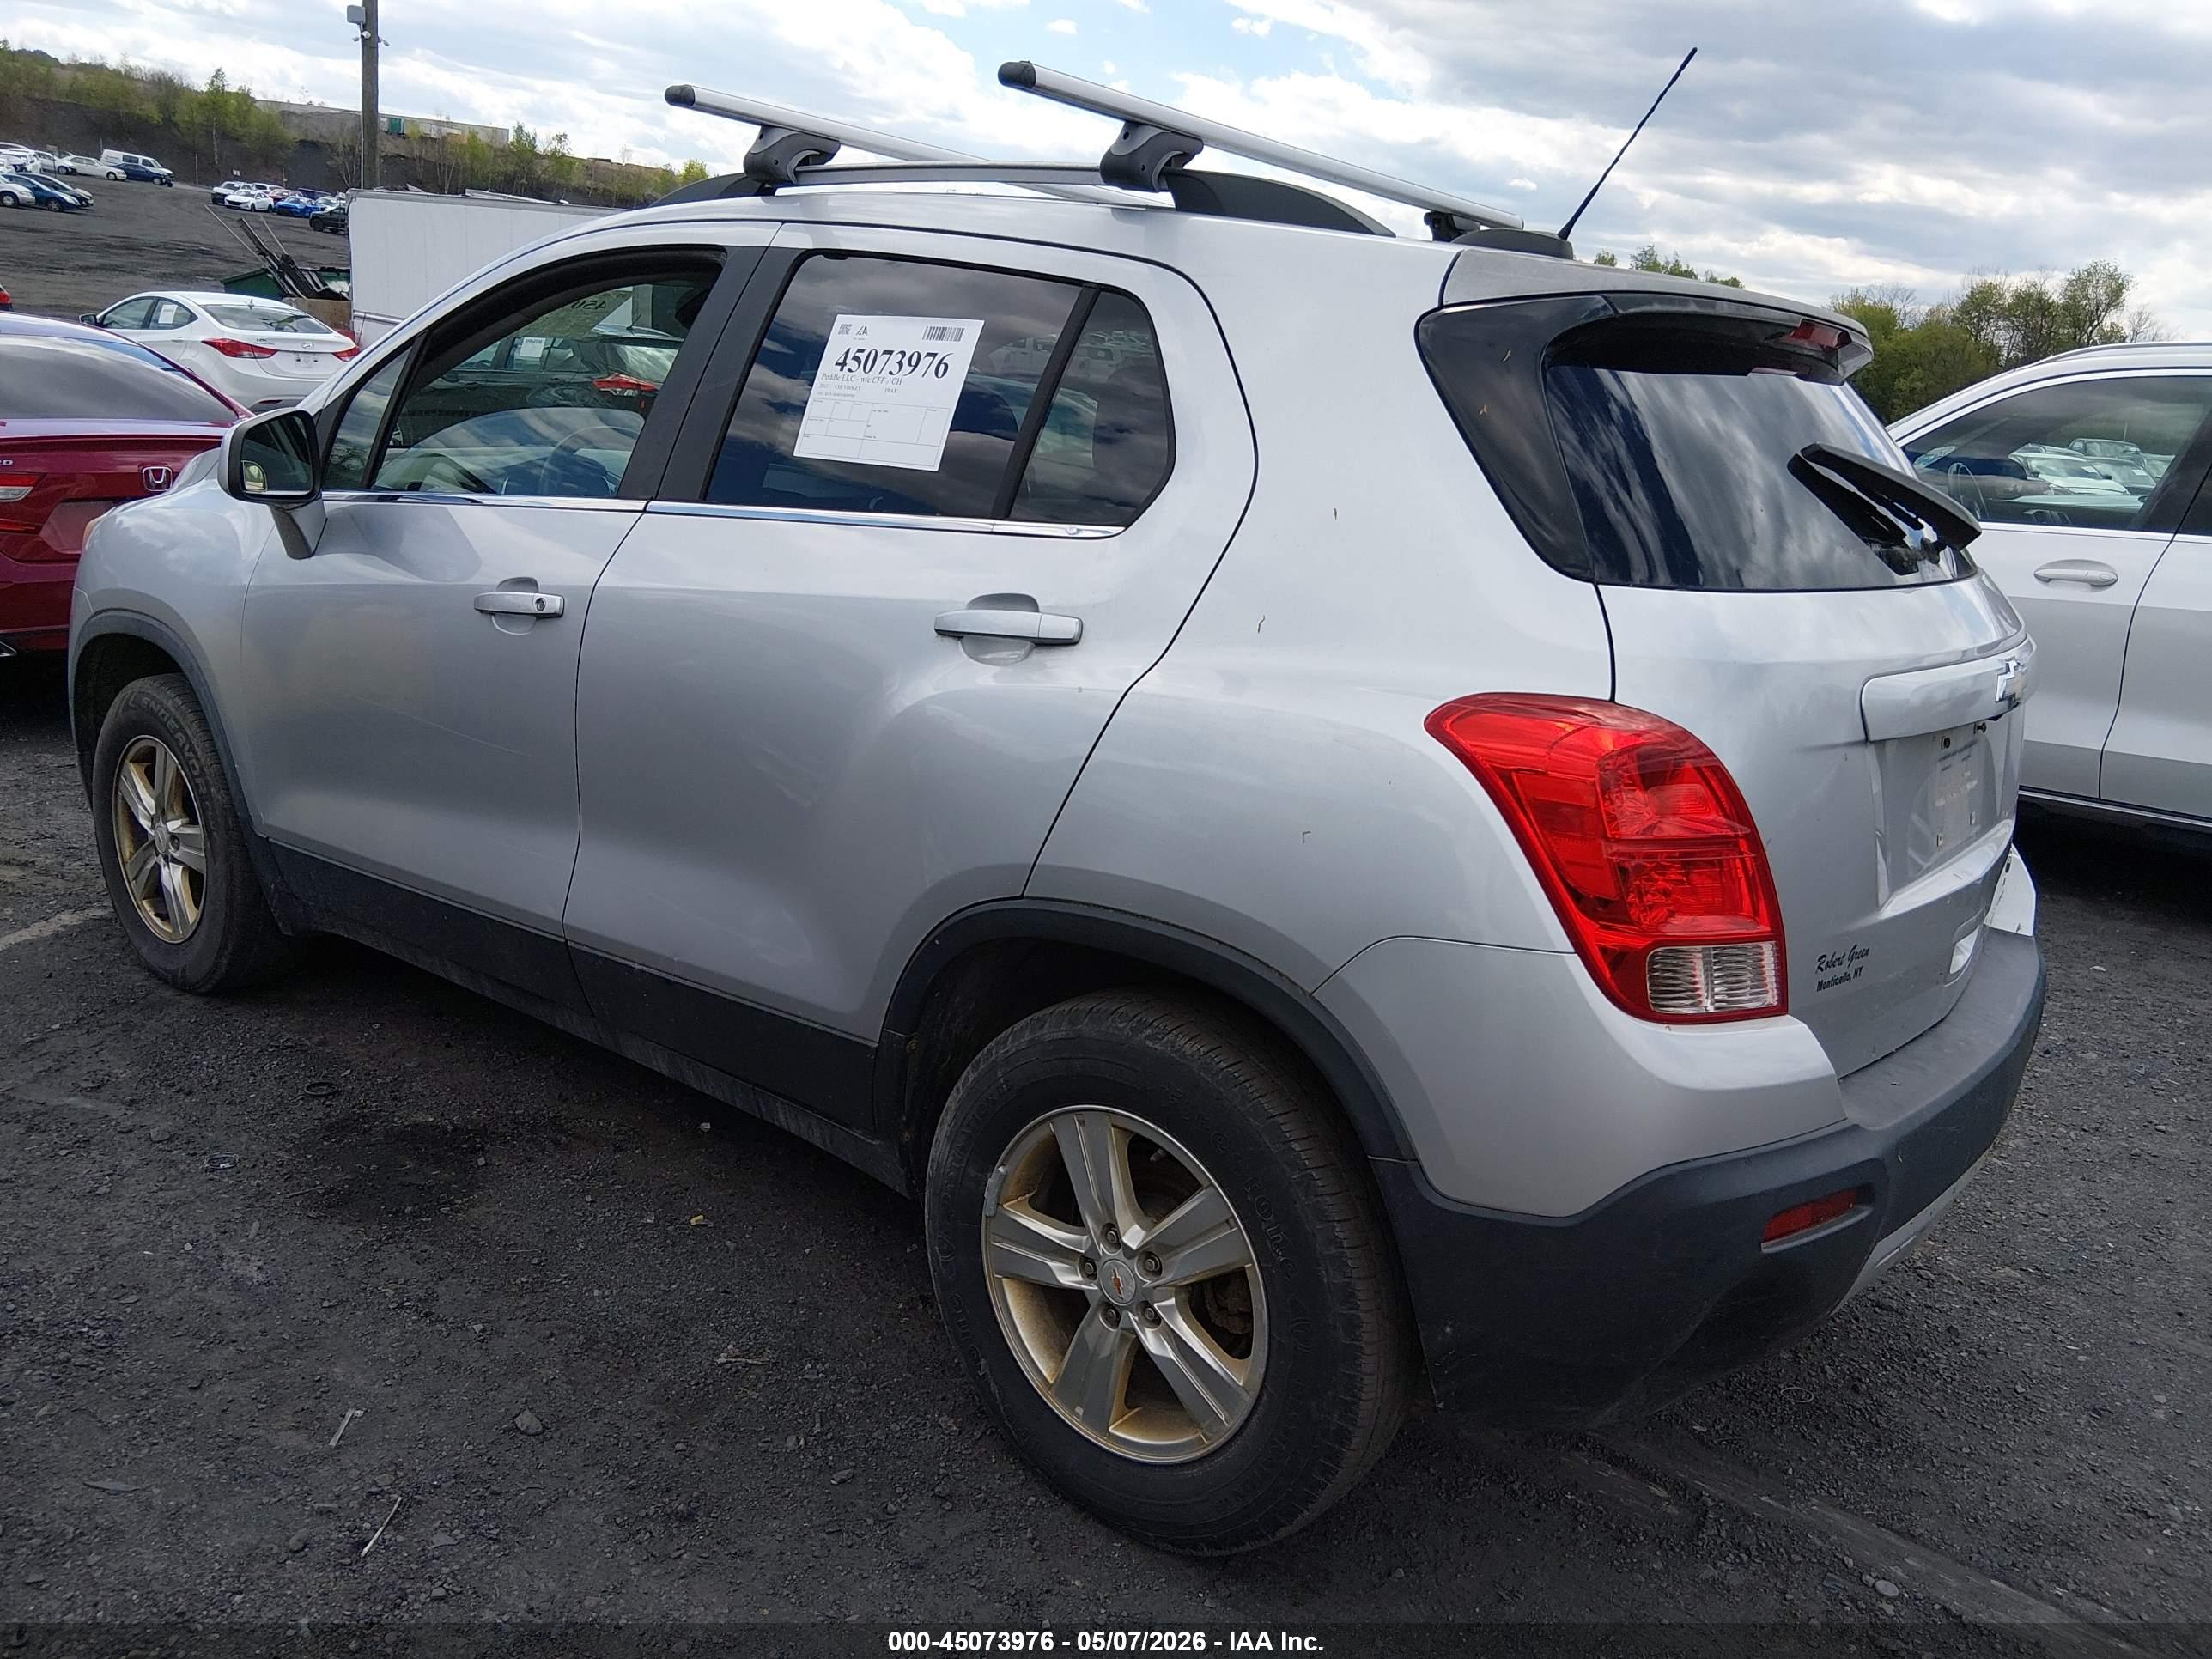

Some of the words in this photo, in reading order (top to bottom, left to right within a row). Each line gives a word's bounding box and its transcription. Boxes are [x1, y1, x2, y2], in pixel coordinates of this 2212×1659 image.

[834, 347, 955, 380] 45073976
[1815, 951, 1846, 975] Robert
[1847, 944, 1870, 969] Green
[1816, 971, 1851, 992] Monticello,
[1853, 965, 1863, 980] NY
